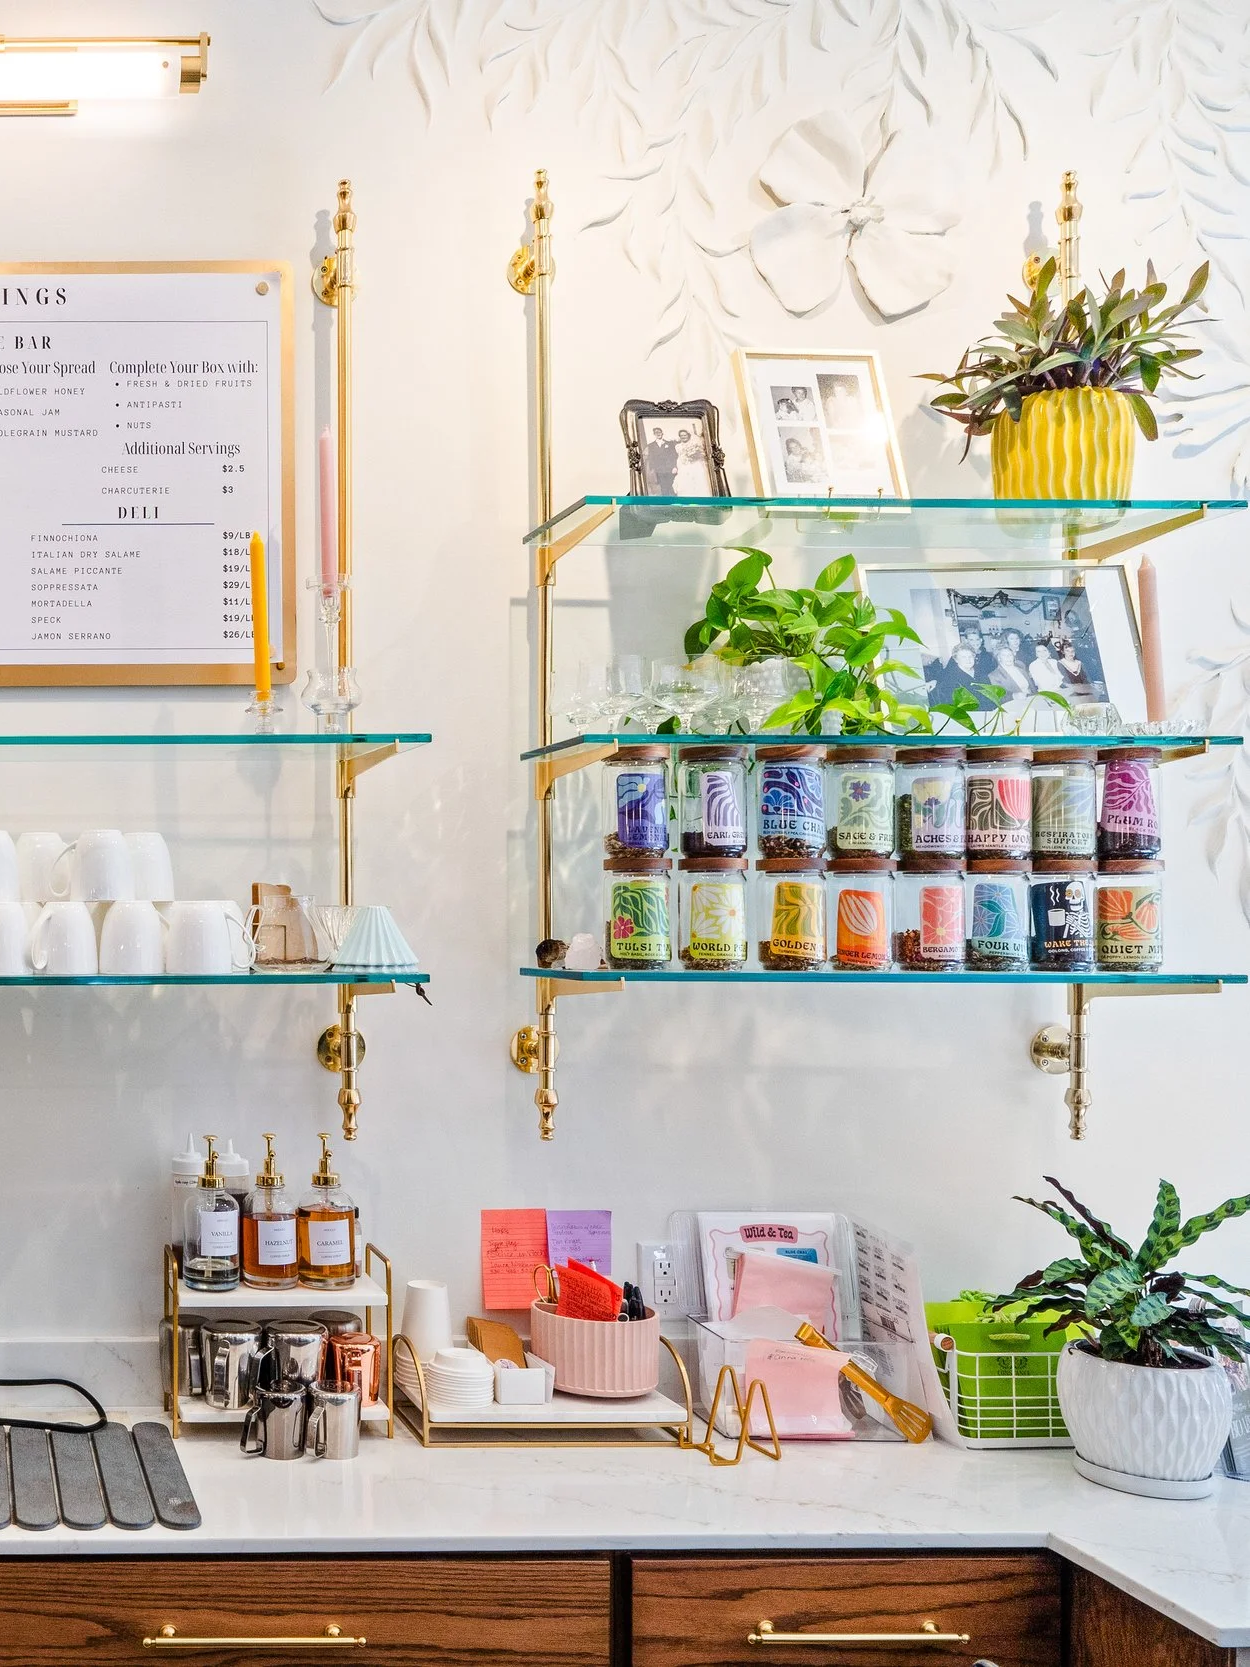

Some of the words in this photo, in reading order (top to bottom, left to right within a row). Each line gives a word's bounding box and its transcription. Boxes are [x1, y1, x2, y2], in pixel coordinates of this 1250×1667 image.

[16, 336, 50, 349] BAR
[22, 362, 50, 374] Your
[54, 361, 95, 377] Spread
[110, 361, 166, 377] Complete
[170, 361, 198, 373] Your
[203, 361, 224, 373] Box
[224, 360, 257, 373] with:
[124, 442, 185, 454] Additional
[189, 442, 240, 457] Servings
[222, 486, 233, 494] $3
[119, 507, 158, 518] DELI
[223, 548, 250, 556] $18/L
[223, 598, 251, 606] $11/L
[223, 614, 253, 622] $19/L
[763, 819, 797, 830] BLUE
[1107, 815, 1144, 828] PLUM
[839, 832, 866, 840] SAGE
[915, 834, 951, 843] ACHES
[967, 834, 1008, 844] HAPPY
[617, 942, 652, 951] TULSI
[692, 942, 731, 951] WORLD
[772, 938, 817, 951] GOLDEN
[978, 940, 1009, 950] FOUR
[1044, 940, 1072, 948] WAKE
[1101, 945, 1144, 954] QUIET
[744, 1227, 765, 1239] Wild
[767, 1227, 777, 1238] &
[778, 1228, 794, 1240] Tea
